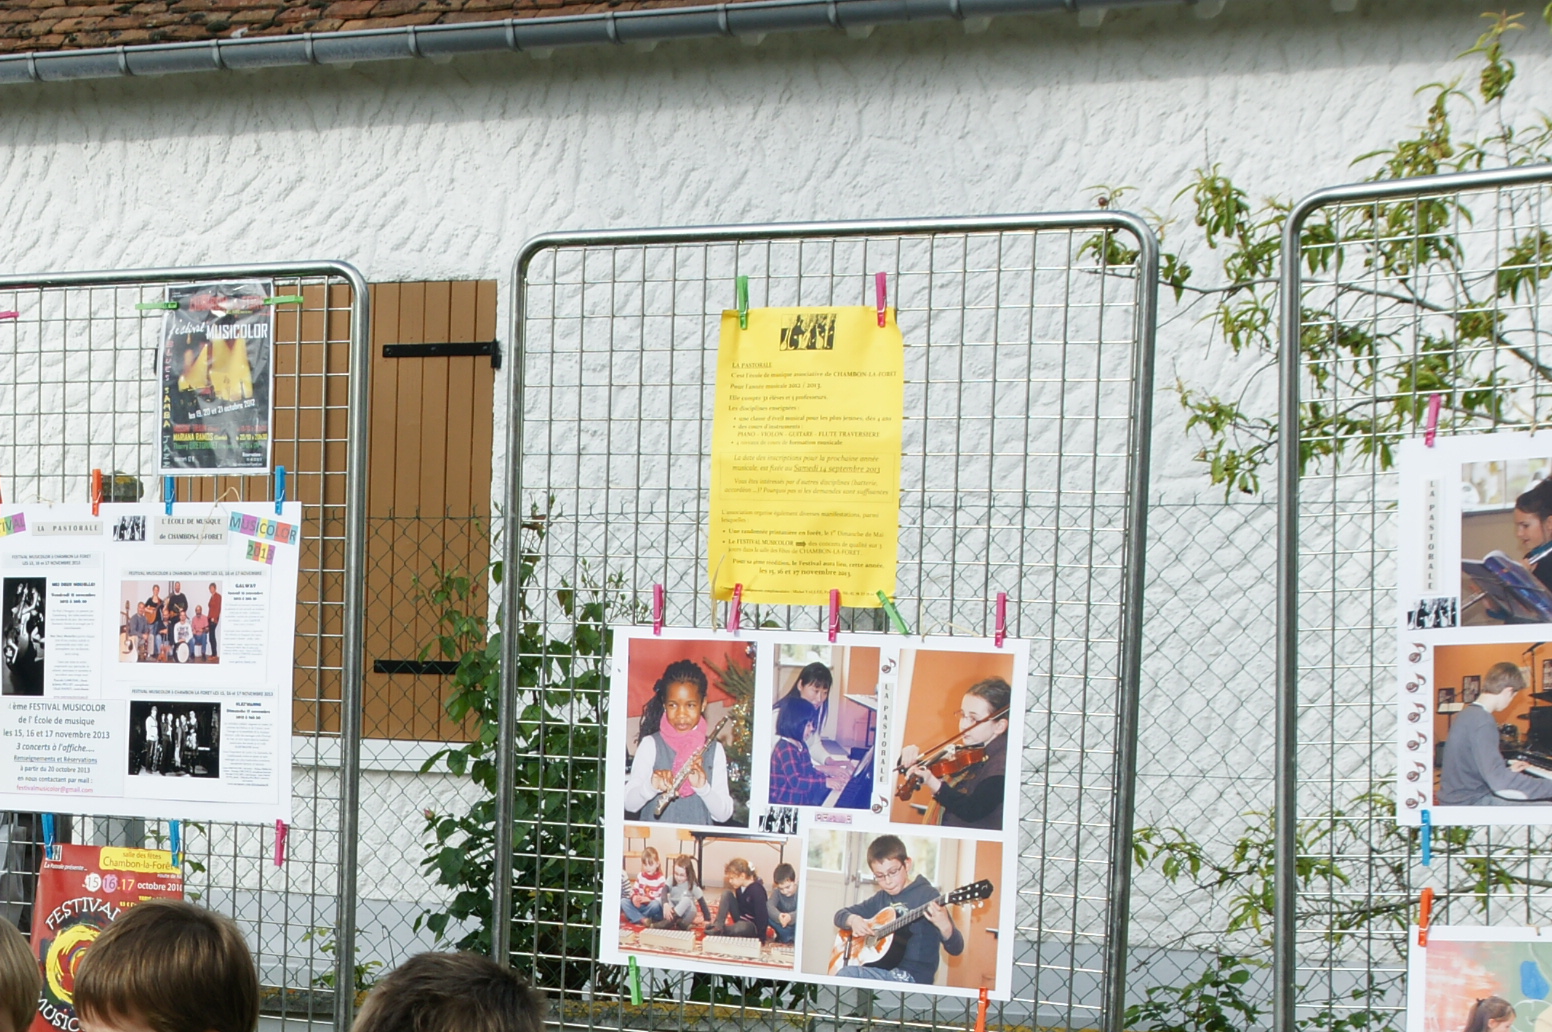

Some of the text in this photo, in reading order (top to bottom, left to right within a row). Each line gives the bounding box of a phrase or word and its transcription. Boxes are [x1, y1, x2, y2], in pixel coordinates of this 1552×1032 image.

[206, 323, 268, 339] MUSICOLOR
[163, 386, 171, 428] SAMBA
[203, 407, 211, 416] 20
[224, 402, 244, 412] octobre
[162, 435, 171, 468] JAZZ
[52, 524, 98, 532] PASTORALE
[229, 516, 298, 542] MUSICOLOR
[247, 544, 274, 561] 2013
[1427, 504, 1435, 590] PASTORALE
[801, 568, 837, 576] novembre
[28, 702, 61, 712] FESTIVAL
[62, 702, 106, 712] MUSICOLOR
[18, 715, 27, 724] de
[34, 714, 52, 724] École
[53, 716, 63, 725] de
[64, 716, 95, 726] musique
[3, 728, 13, 737] les
[26, 729, 35, 738] 16
[36, 730, 44, 738] et
[45, 729, 54, 738] 17
[54, 729, 91, 739] novembre
[92, 730, 110, 740] 2013
[16, 742, 21, 751] 3
[21, 742, 51, 752] concerts
[879, 705, 889, 783] PASTORALE
[13, 755, 56, 763] Renseignements
[63, 756, 98, 764] Réservations
[24, 766, 39, 774] partir
[55, 766, 76, 774] octobre
[77, 766, 91, 774] 2013
[122, 851, 134, 859] salle
[136, 851, 146, 859] des
[43, 861, 50, 869] La
[87, 877, 99, 888] 15
[103, 877, 116, 889] 16
[137, 881, 167, 891] octobre
